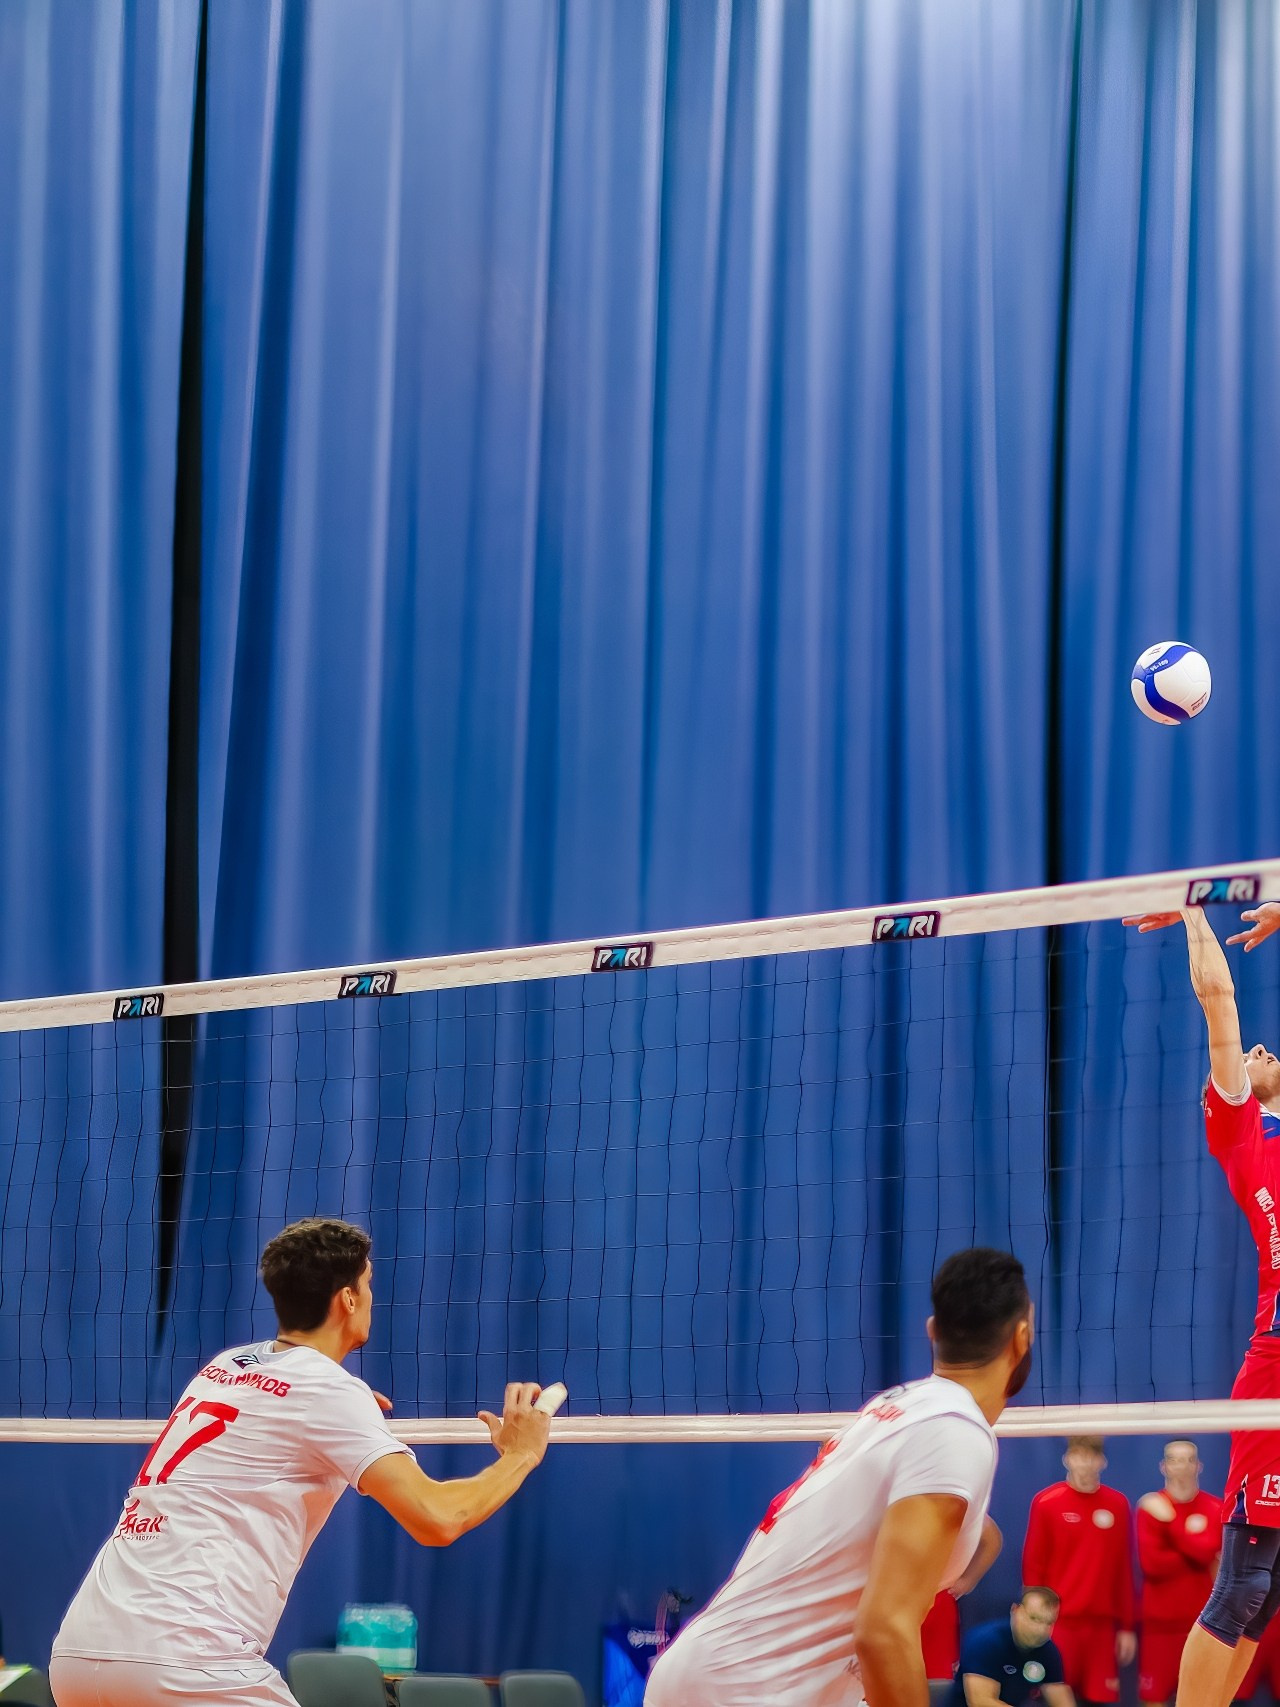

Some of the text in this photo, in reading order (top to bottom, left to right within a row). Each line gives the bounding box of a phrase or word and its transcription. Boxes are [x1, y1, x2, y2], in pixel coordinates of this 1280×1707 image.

[1190, 878, 1255, 904] PARI
[877, 914, 935, 940] PARI
[597, 946, 647, 968] PARI
[342, 974, 391, 996] PARI
[117, 996, 160, 1018] PARI
[134, 1396, 240, 1487] 17
